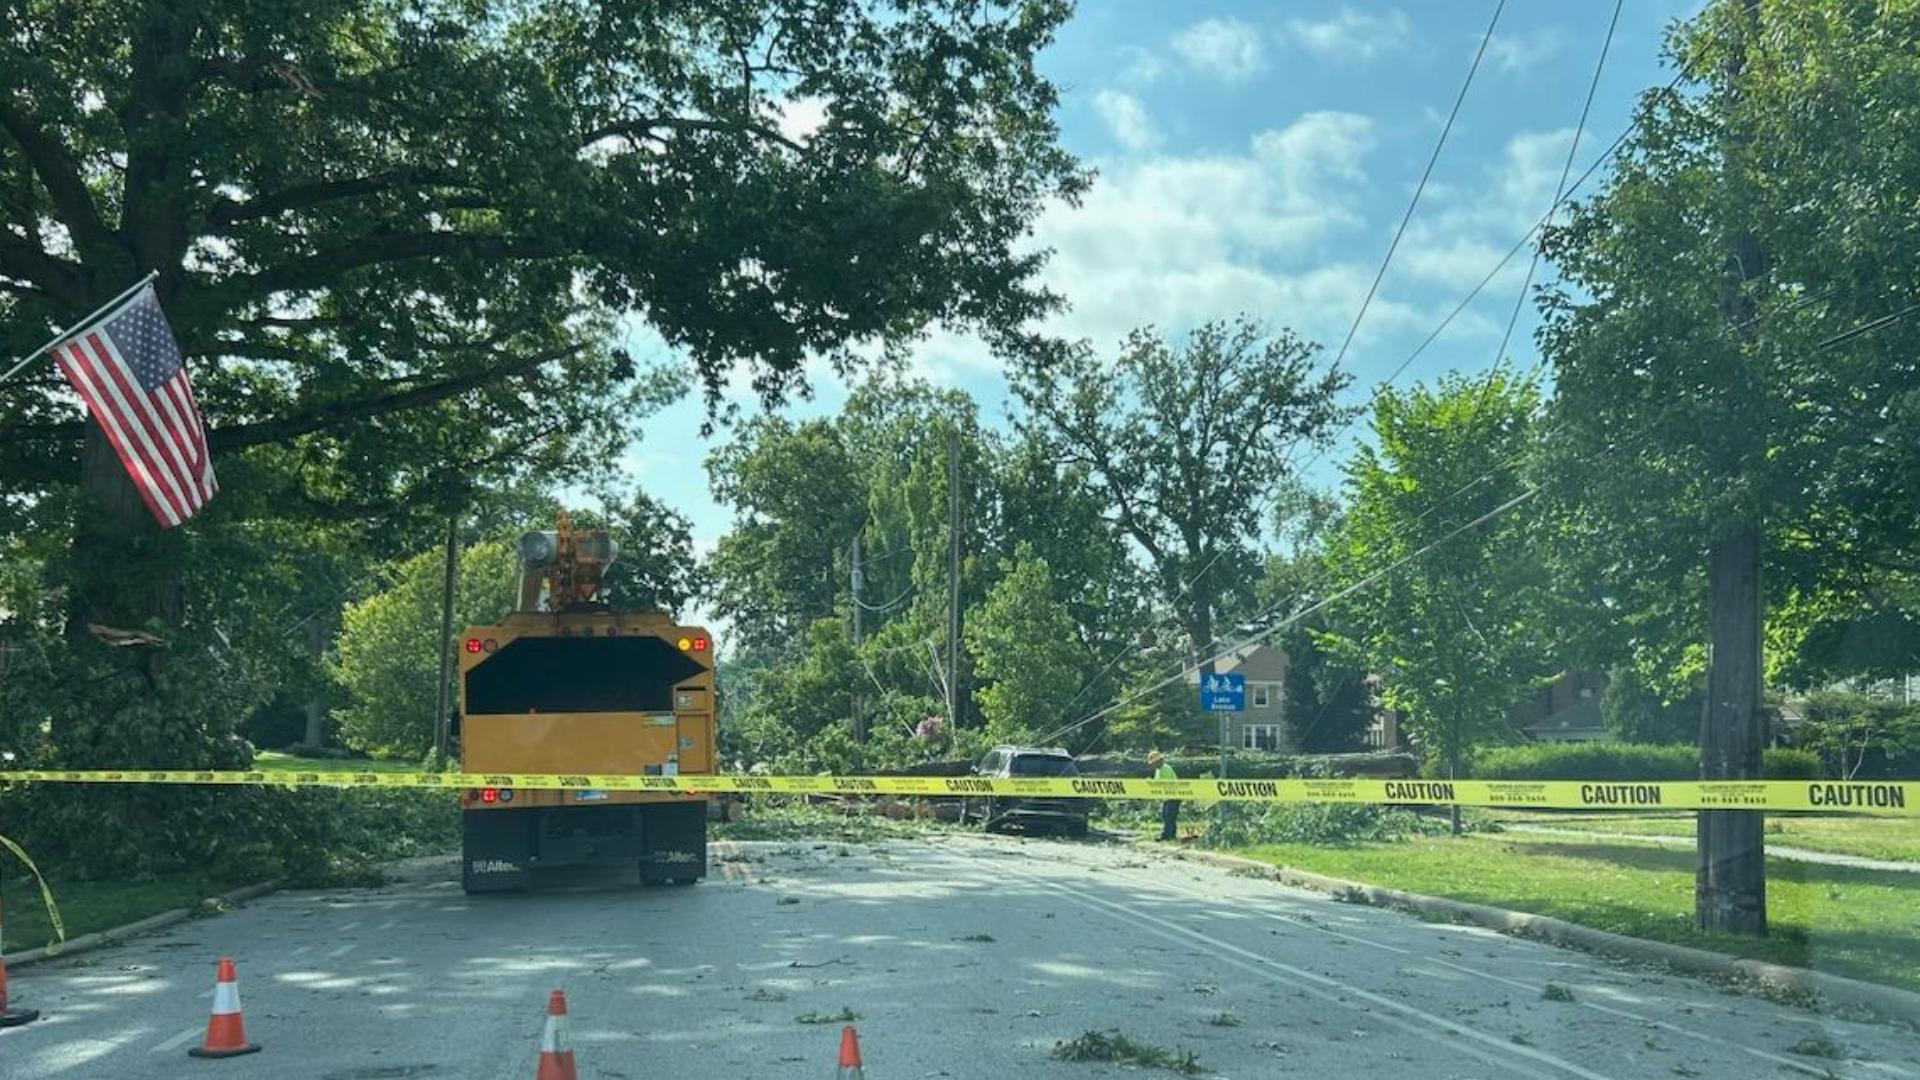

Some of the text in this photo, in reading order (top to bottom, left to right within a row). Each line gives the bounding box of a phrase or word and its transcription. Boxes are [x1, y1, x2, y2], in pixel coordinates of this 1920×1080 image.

[945, 780, 994, 792] CAUTION
[1072, 780, 1126, 794] CAUTION
[1217, 781, 1278, 797] CAUTION
[1385, 783, 1455, 800] CAUTION
[1582, 785, 1661, 804] CAUTION
[1808, 784, 1905, 808] CAUTION
